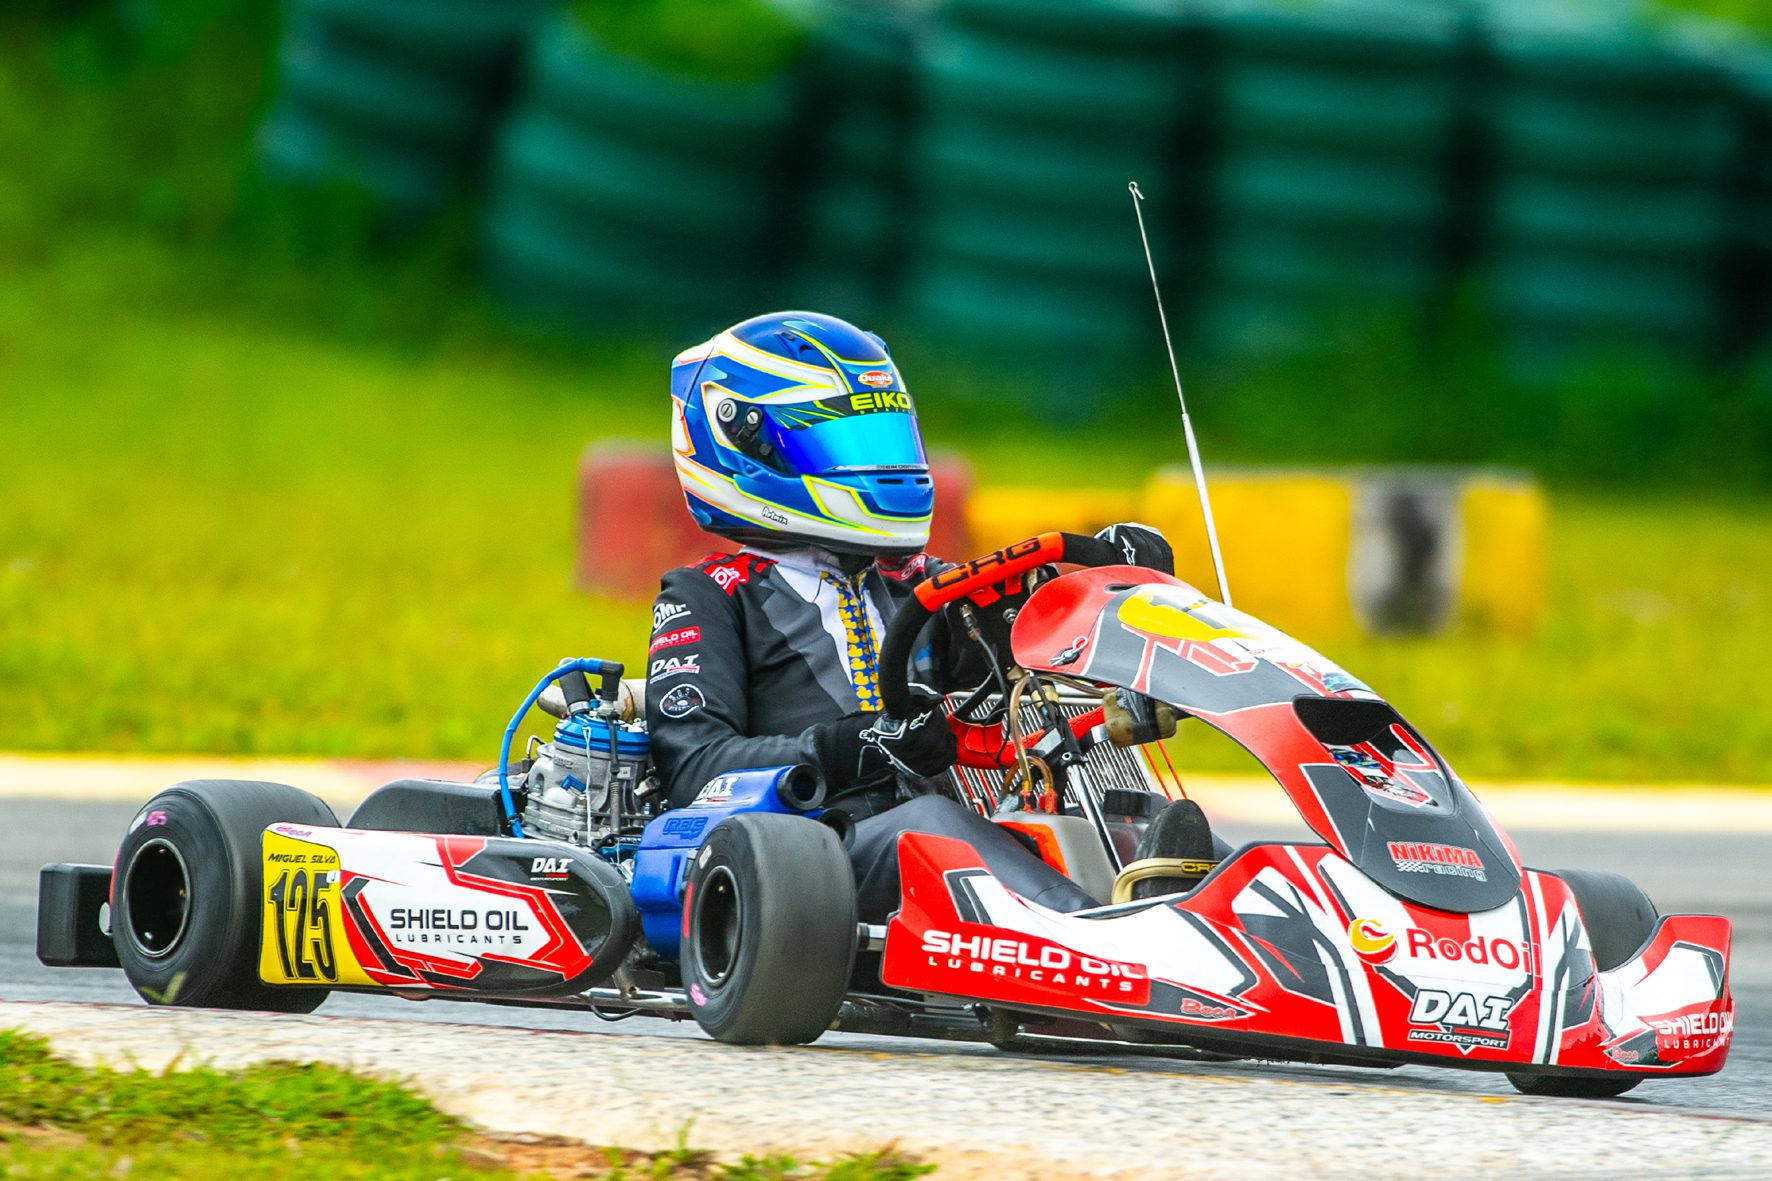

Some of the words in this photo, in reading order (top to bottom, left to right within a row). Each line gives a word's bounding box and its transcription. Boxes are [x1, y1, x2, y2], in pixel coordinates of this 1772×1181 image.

[850, 392, 912, 411] EIKO
[932, 537, 1041, 589] CRG
[680, 629, 698, 639] OIL
[651, 654, 699, 676] DAI
[268, 853, 306, 863] MIGUEL
[310, 855, 336, 864] SILVA
[531, 857, 574, 873] DAI
[1421, 863, 1487, 882] racing
[268, 867, 338, 982] 125
[390, 908, 477, 930] SHIELD
[485, 909, 529, 931] OIL
[396, 934, 522, 944] LUBRICANTS
[921, 929, 1071, 970] SHIELD
[1080, 956, 1144, 980] OIL
[1406, 927, 1543, 977] RodOil
[928, 956, 1133, 992] LUBRICANTS
[1410, 988, 1514, 1030] DAI
[1650, 1011, 1719, 1035] SHIELD
[1410, 1031, 1507, 1048] MOTORSPORT
[1664, 1037, 1733, 1049] LUBRICANT
